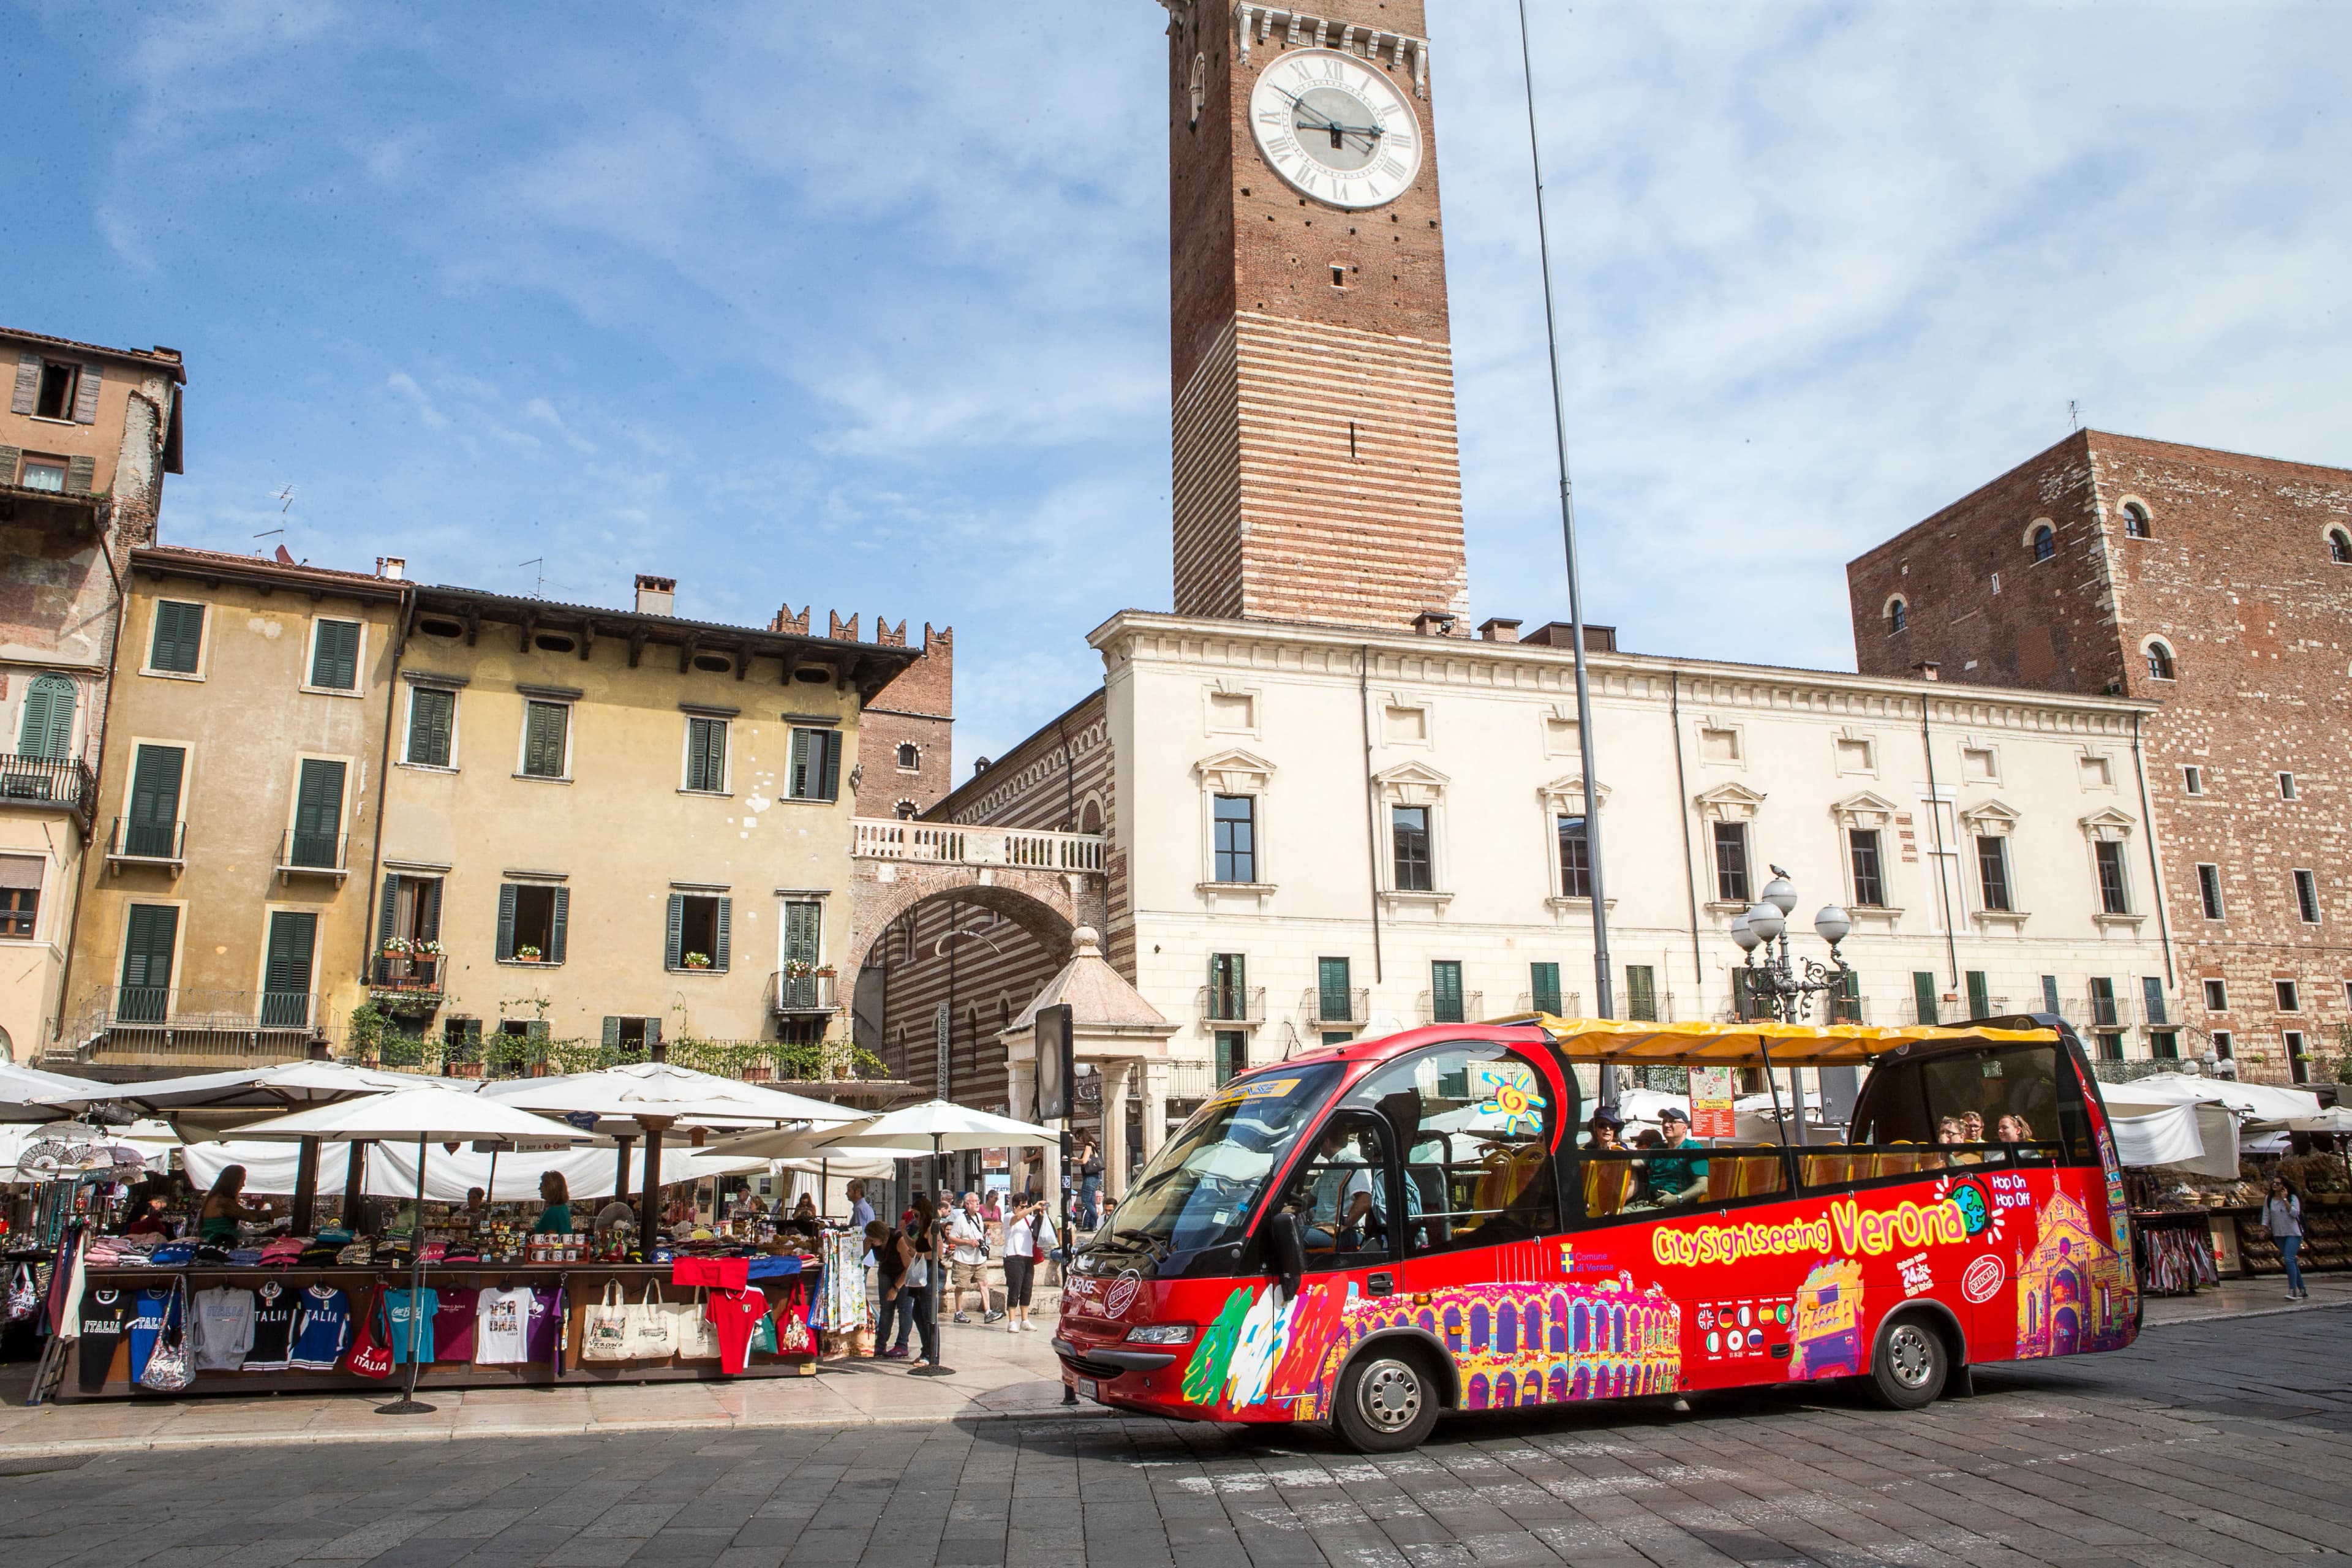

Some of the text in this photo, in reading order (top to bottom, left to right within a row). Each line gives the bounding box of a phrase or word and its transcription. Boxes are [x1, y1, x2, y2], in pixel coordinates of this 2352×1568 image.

[1992, 1175, 2027, 1190] Hop On
[1995, 1192, 2030, 1208] Hop Off
[1653, 1199, 1967, 1267] CitySightseeing Verona
[1576, 1252, 1608, 1261] Comune
[1577, 1263, 1584, 1272] di
[1970, 1258, 1985, 1271] TOUR
[1970, 1266, 1997, 1291] OFFICIAL
[1109, 1283, 1133, 1303] OFFICIAL
[1985, 1280, 2001, 1298] VERONA
[207, 1305, 244, 1317] ITALIA
[255, 1310, 287, 1322] TALIA
[306, 1310, 337, 1323] TALIA
[83, 1319, 121, 1334] ITALIA
[363, 1346, 373, 1358] I
[354, 1355, 387, 1372] ITALIA
